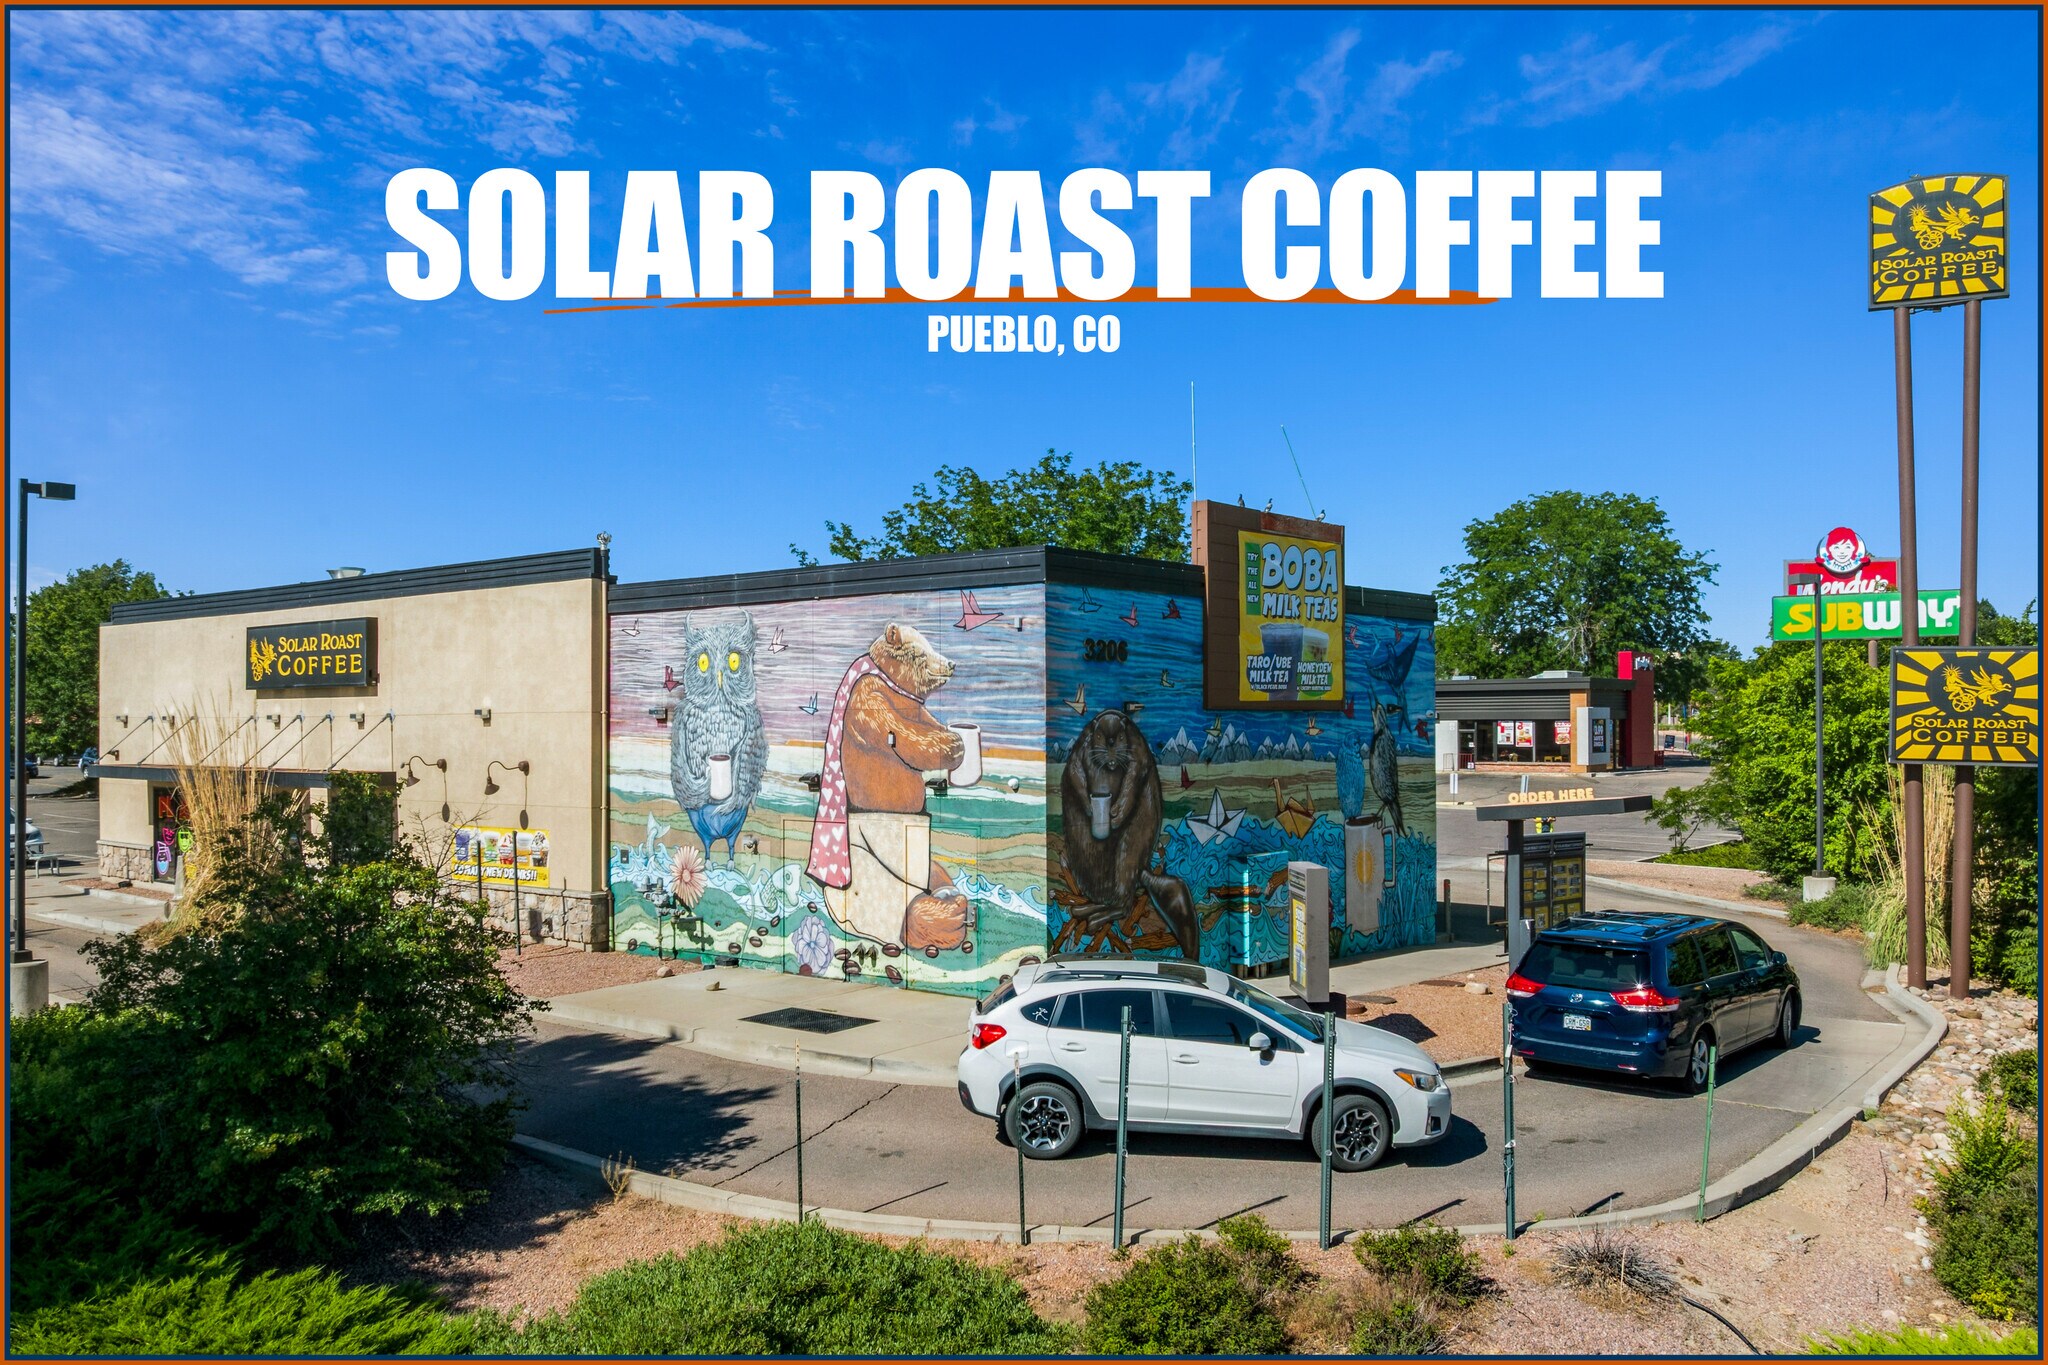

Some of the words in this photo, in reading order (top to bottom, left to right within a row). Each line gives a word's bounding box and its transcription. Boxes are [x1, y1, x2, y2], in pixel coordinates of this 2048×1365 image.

[1880, 255, 1936, 270] SOLAR
[1941, 249, 1998, 264] ROAST
[1879, 260, 1998, 285] COFFEE
[1247, 552, 1259, 561] TRY
[1247, 566, 1259, 576] THE
[1262, 542, 1339, 595] BOBA
[1248, 581, 1257, 589] ALL
[1246, 594, 1259, 603] NEW
[1262, 592, 1301, 619] MILK
[1304, 596, 1339, 622] TEAS
[278, 636, 318, 653] SOLAR
[321, 633, 363, 651] ROAST
[1084, 637, 1129, 662] 3206
[277, 653, 363, 677] COFFEE
[1247, 654, 1293, 671] TARO/UBE
[1297, 662, 1333, 673] HONEYDEW
[1249, 670, 1272, 683] MILK
[1273, 670, 1289, 683] TEA
[1300, 674, 1316, 685] MILK
[1316, 674, 1328, 685] TEA
[1913, 716, 1968, 729] SOLAR
[1973, 717, 2028, 729] ROAST
[1912, 728, 2028, 744] COFFEE
[1508, 791, 1554, 804] ORDER
[1558, 787, 1594, 801] HERE
[486, 866, 504, 879] NEW
[502, 867, 538, 882] DRNKS!!
